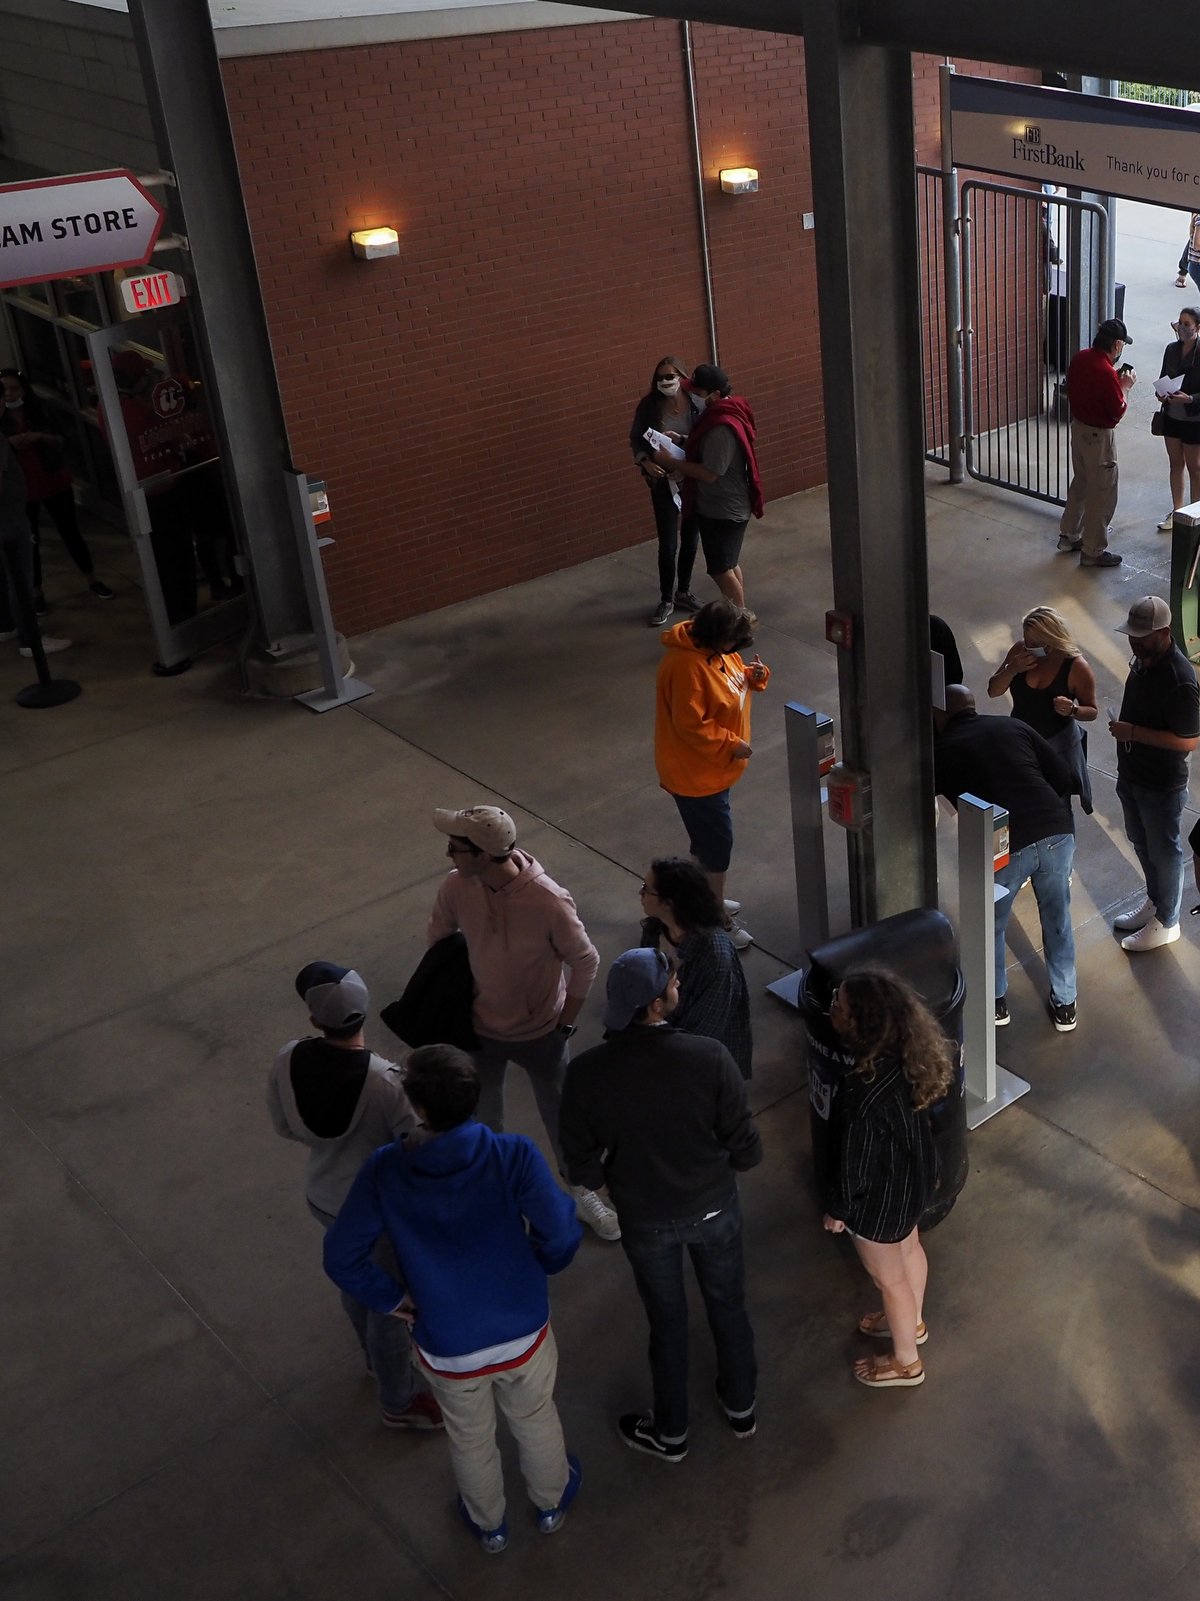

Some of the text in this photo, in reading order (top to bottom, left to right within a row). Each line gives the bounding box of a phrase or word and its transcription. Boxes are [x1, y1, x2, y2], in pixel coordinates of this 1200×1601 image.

[1026, 127, 1040, 143] FB
[1013, 138, 1085, 171] FirstBank
[1107, 156, 1143, 175] Thank
[1146, 166, 1167, 179] you
[1172, 168, 1189, 183] for
[0, 207, 138, 248] AM STORE
[130, 274, 172, 310] EXIT
